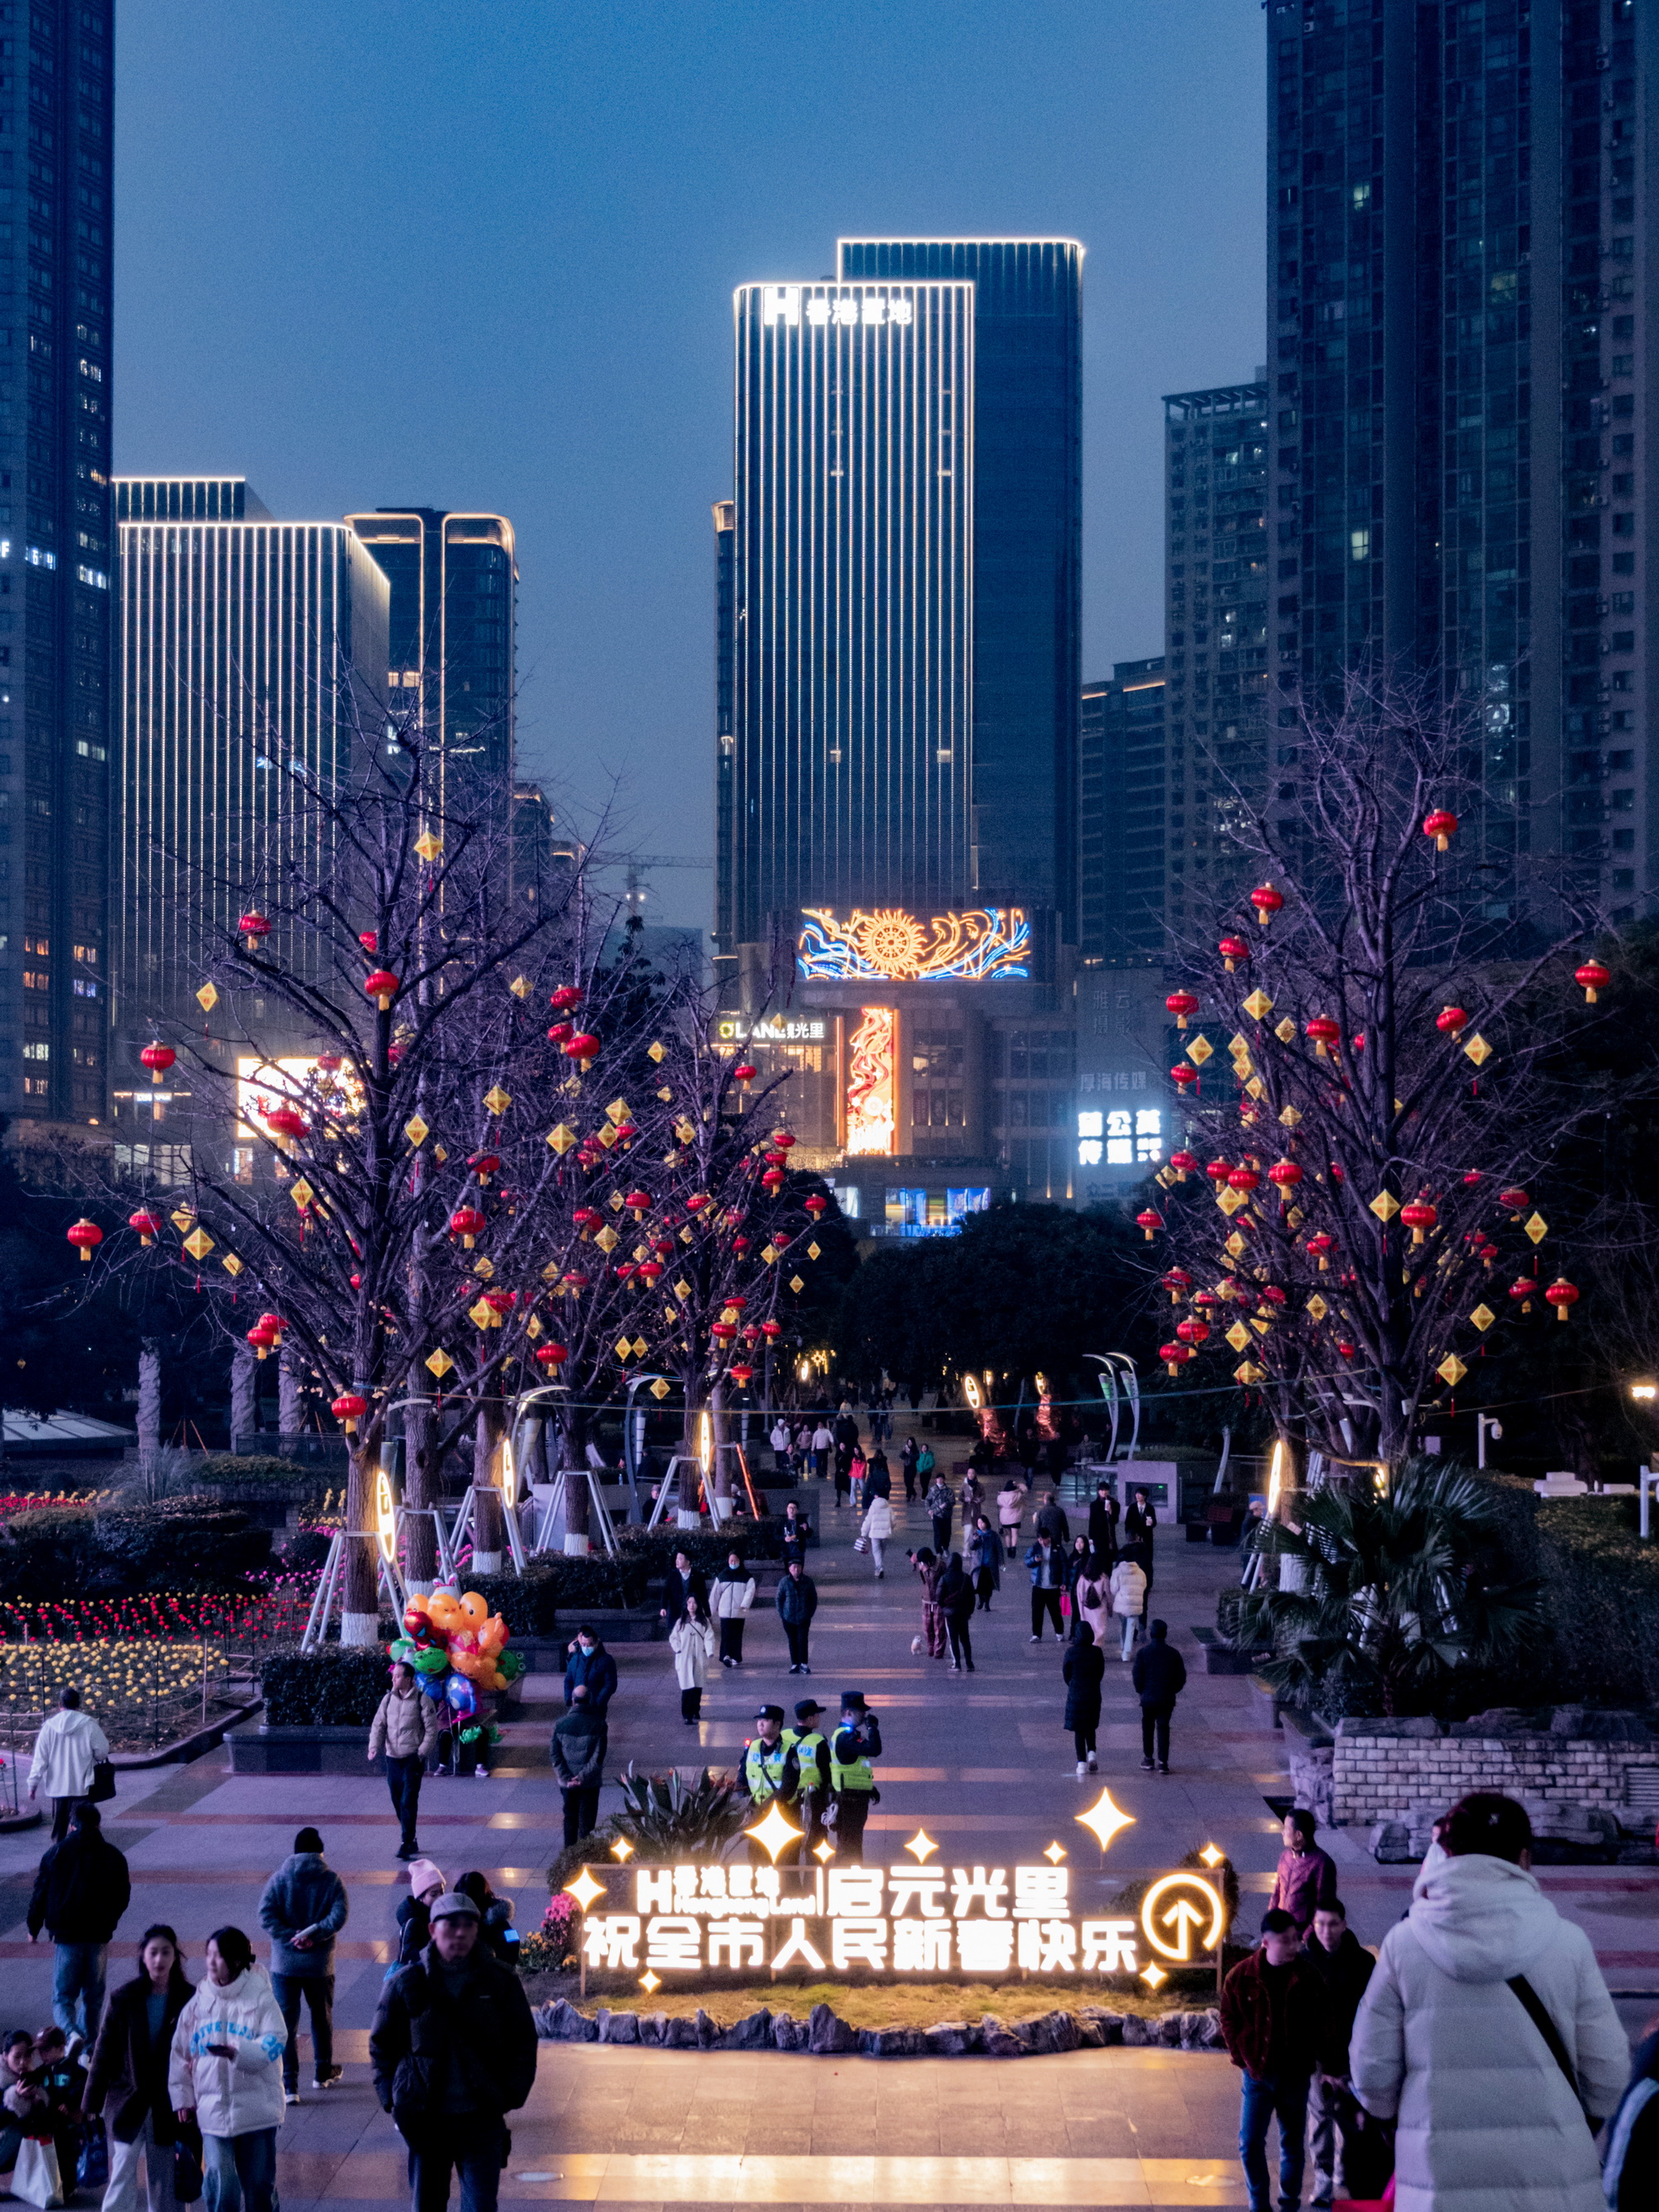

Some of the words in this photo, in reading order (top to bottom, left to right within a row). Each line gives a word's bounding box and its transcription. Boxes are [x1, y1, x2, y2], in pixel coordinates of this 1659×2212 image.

[827, 1865, 1070, 1918] 启元光里
[583, 1916, 1138, 1971] 祝全市人民新春快乐
